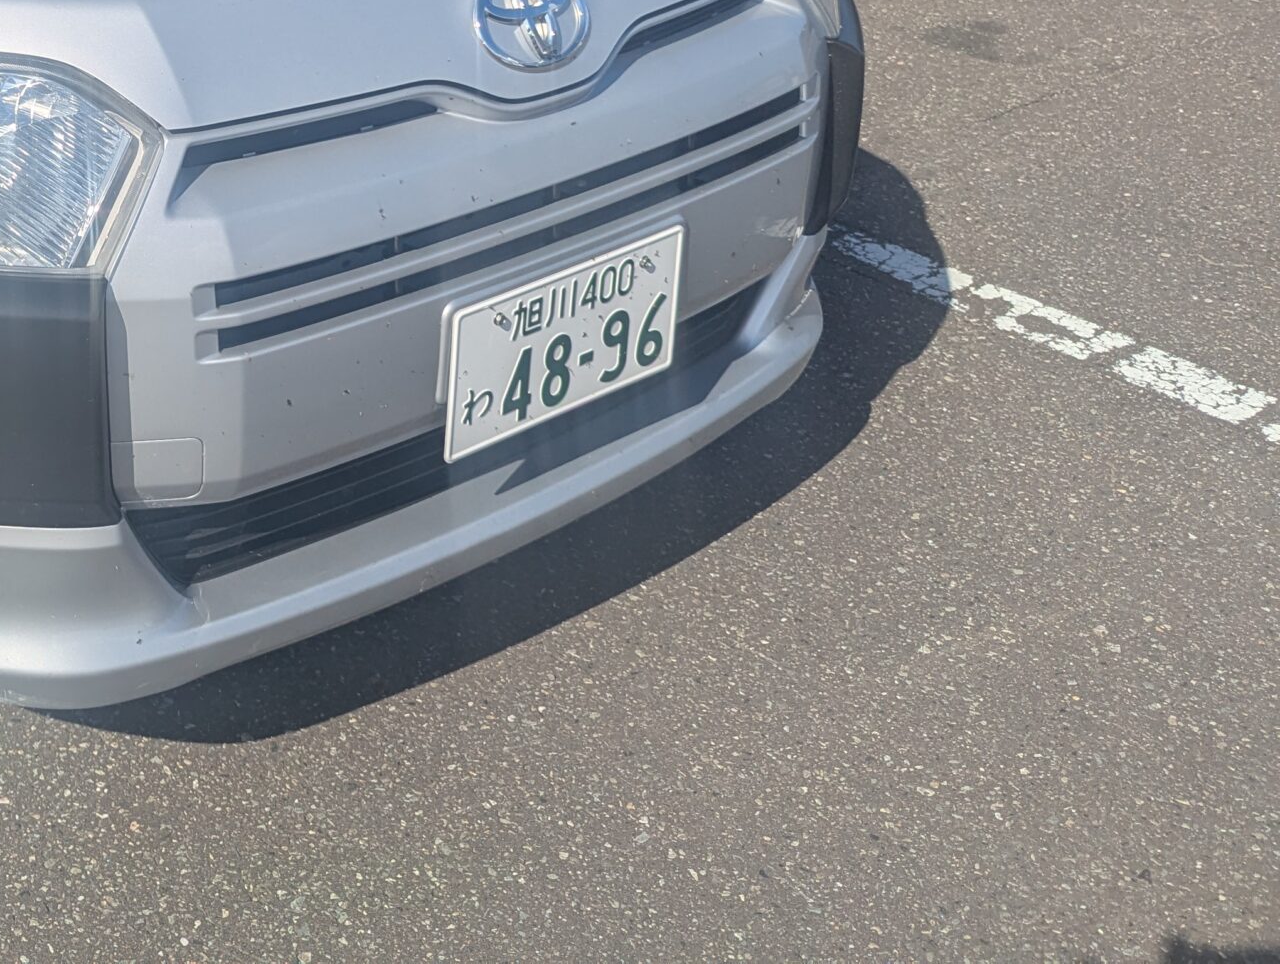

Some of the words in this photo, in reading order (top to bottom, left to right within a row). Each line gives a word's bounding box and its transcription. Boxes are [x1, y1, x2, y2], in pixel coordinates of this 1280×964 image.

[510, 258, 635, 341] 旭川400
[461, 388, 493, 425] わ
[500, 292, 668, 422] 48-96
